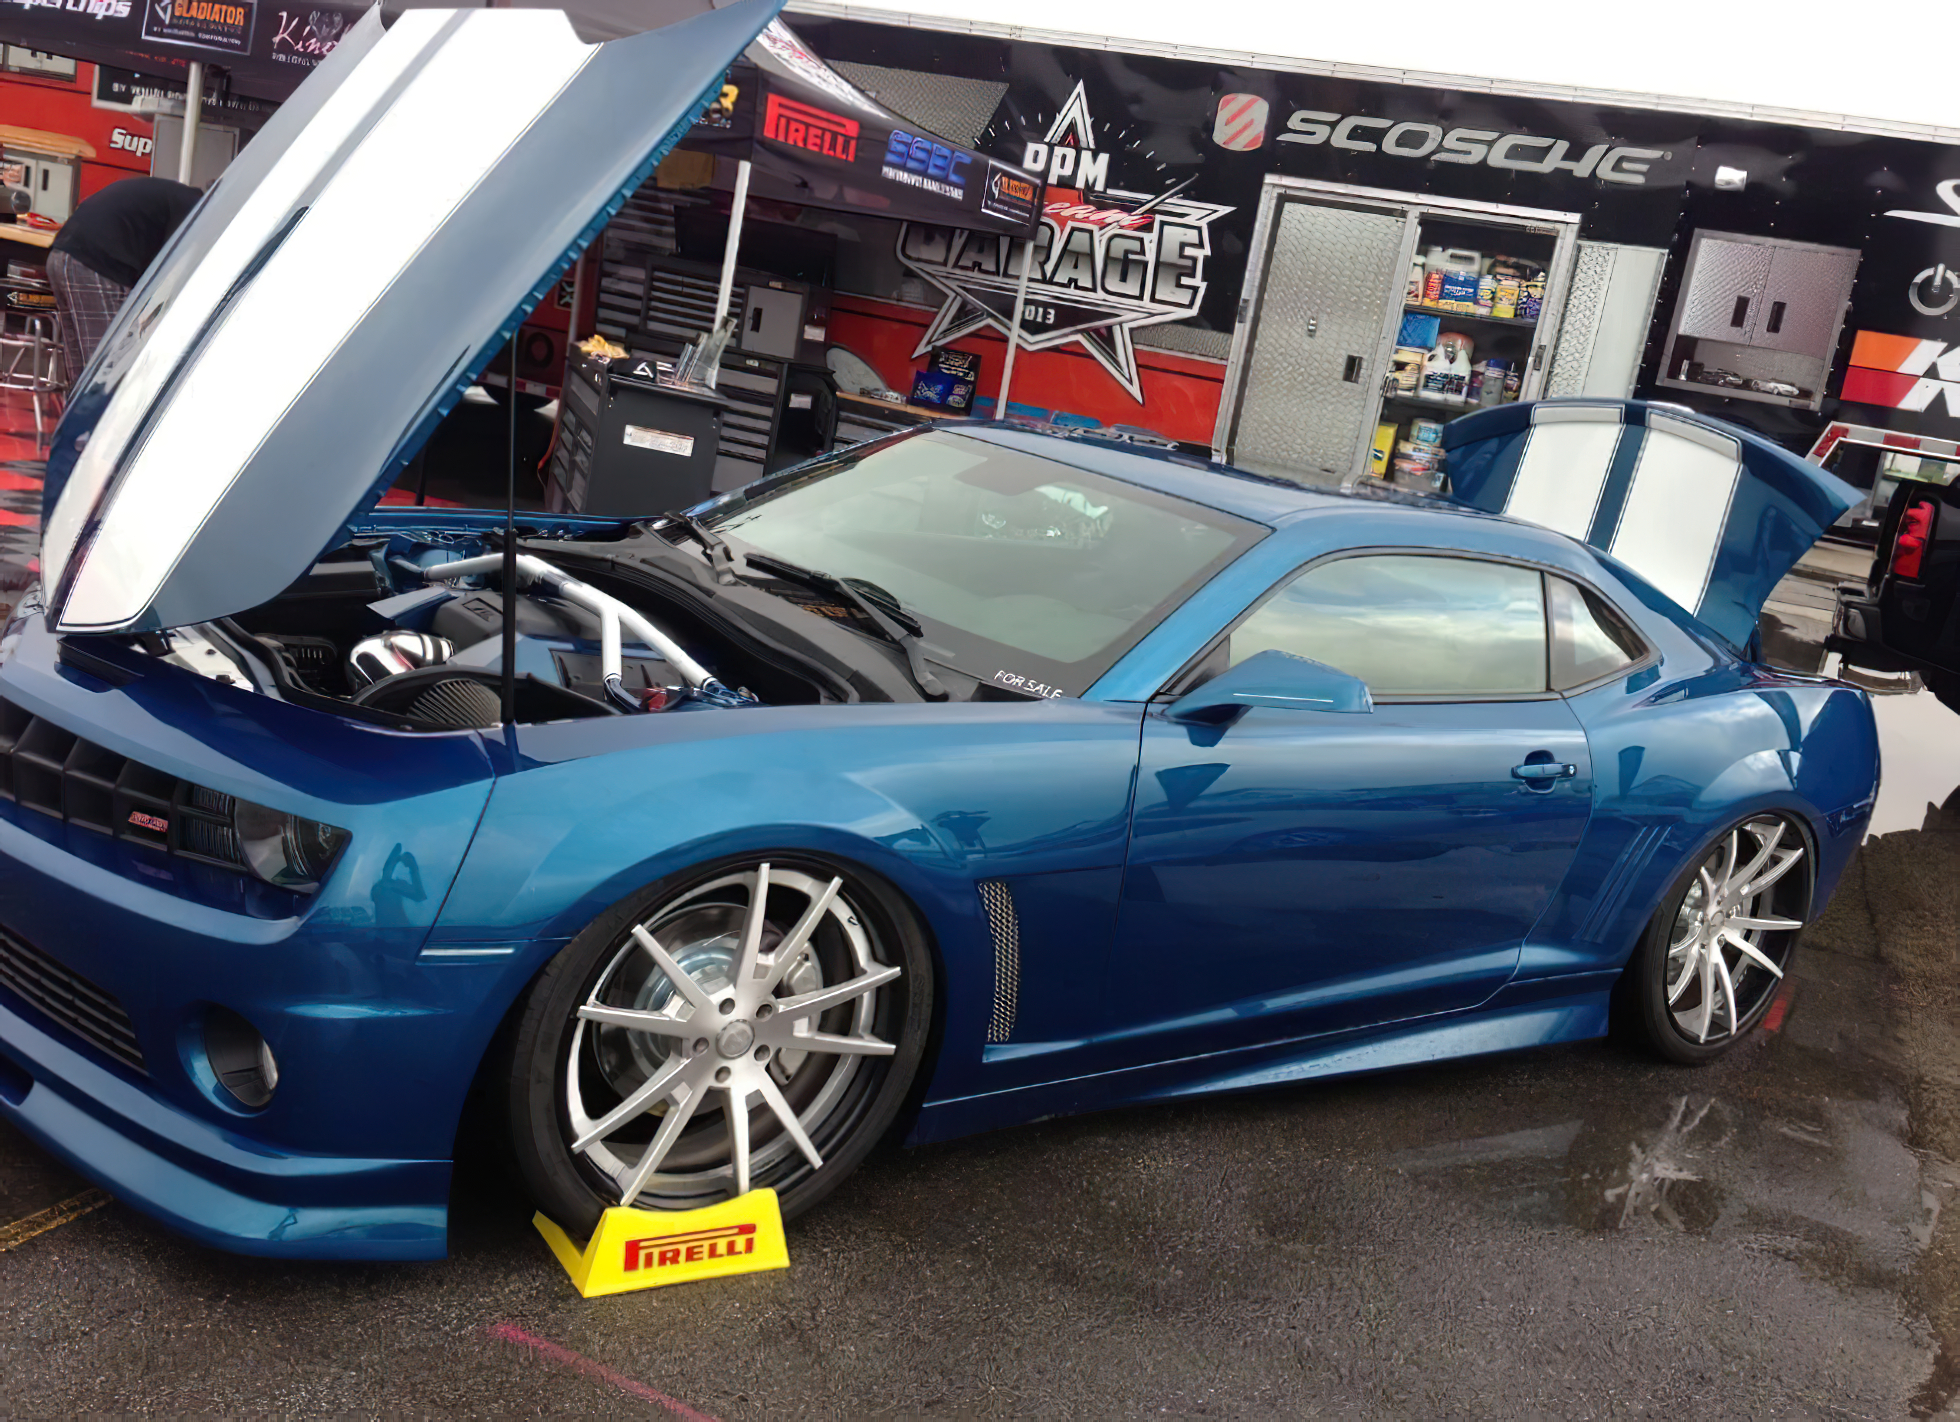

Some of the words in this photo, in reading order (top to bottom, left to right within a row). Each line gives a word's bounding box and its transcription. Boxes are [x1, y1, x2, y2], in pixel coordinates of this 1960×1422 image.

[174, 0, 246, 27] GLADIATOR
[763, 92, 861, 163] PIRELLI
[1276, 109, 1665, 184] SCOSCHE
[1023, 303, 1056, 325] 013
[994, 669, 1026, 688] FOR
[624, 1223, 757, 1272] PIRELLI
